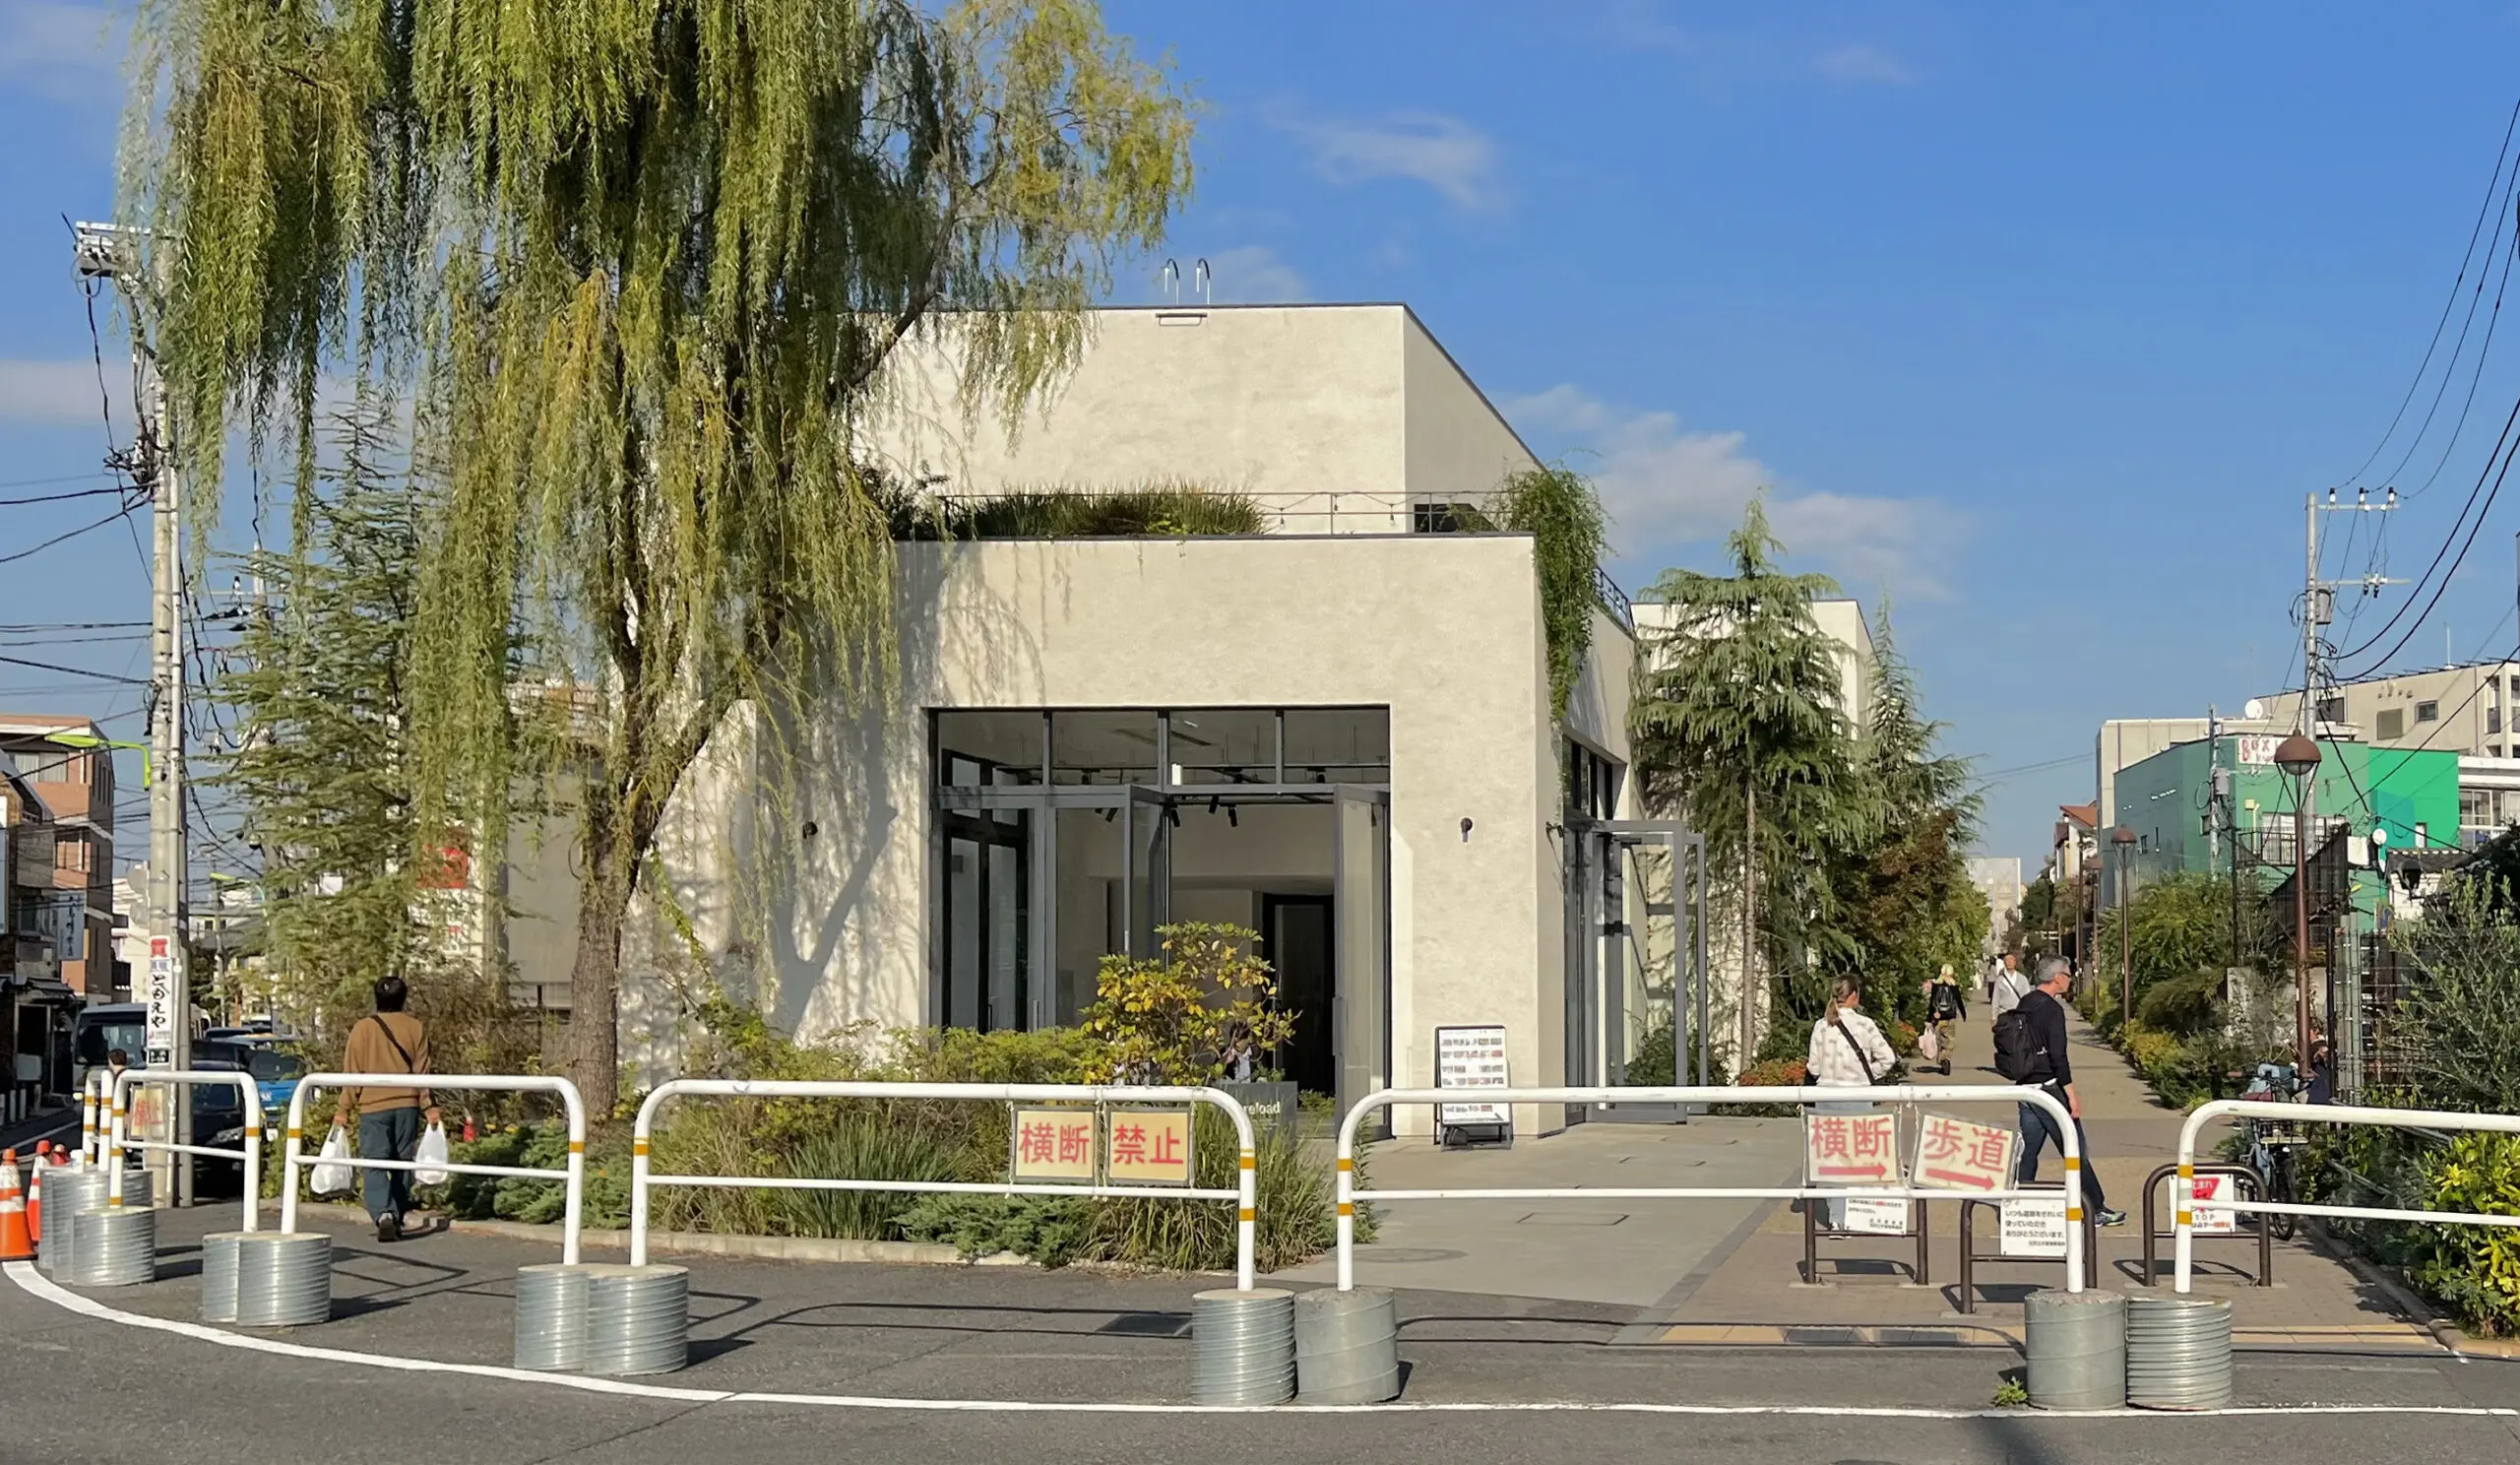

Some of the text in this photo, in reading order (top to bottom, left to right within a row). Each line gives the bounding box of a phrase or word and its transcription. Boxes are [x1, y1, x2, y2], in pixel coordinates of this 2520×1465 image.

[152, 974, 169, 1028] ともえや
[1243, 1101, 1281, 1115] reload
[1019, 1121, 1090, 1165] 横断
[1112, 1123, 1184, 1166] 禁止
[1810, 1116, 1891, 1159] 横断
[1923, 1119, 2008, 1173] 歩道
